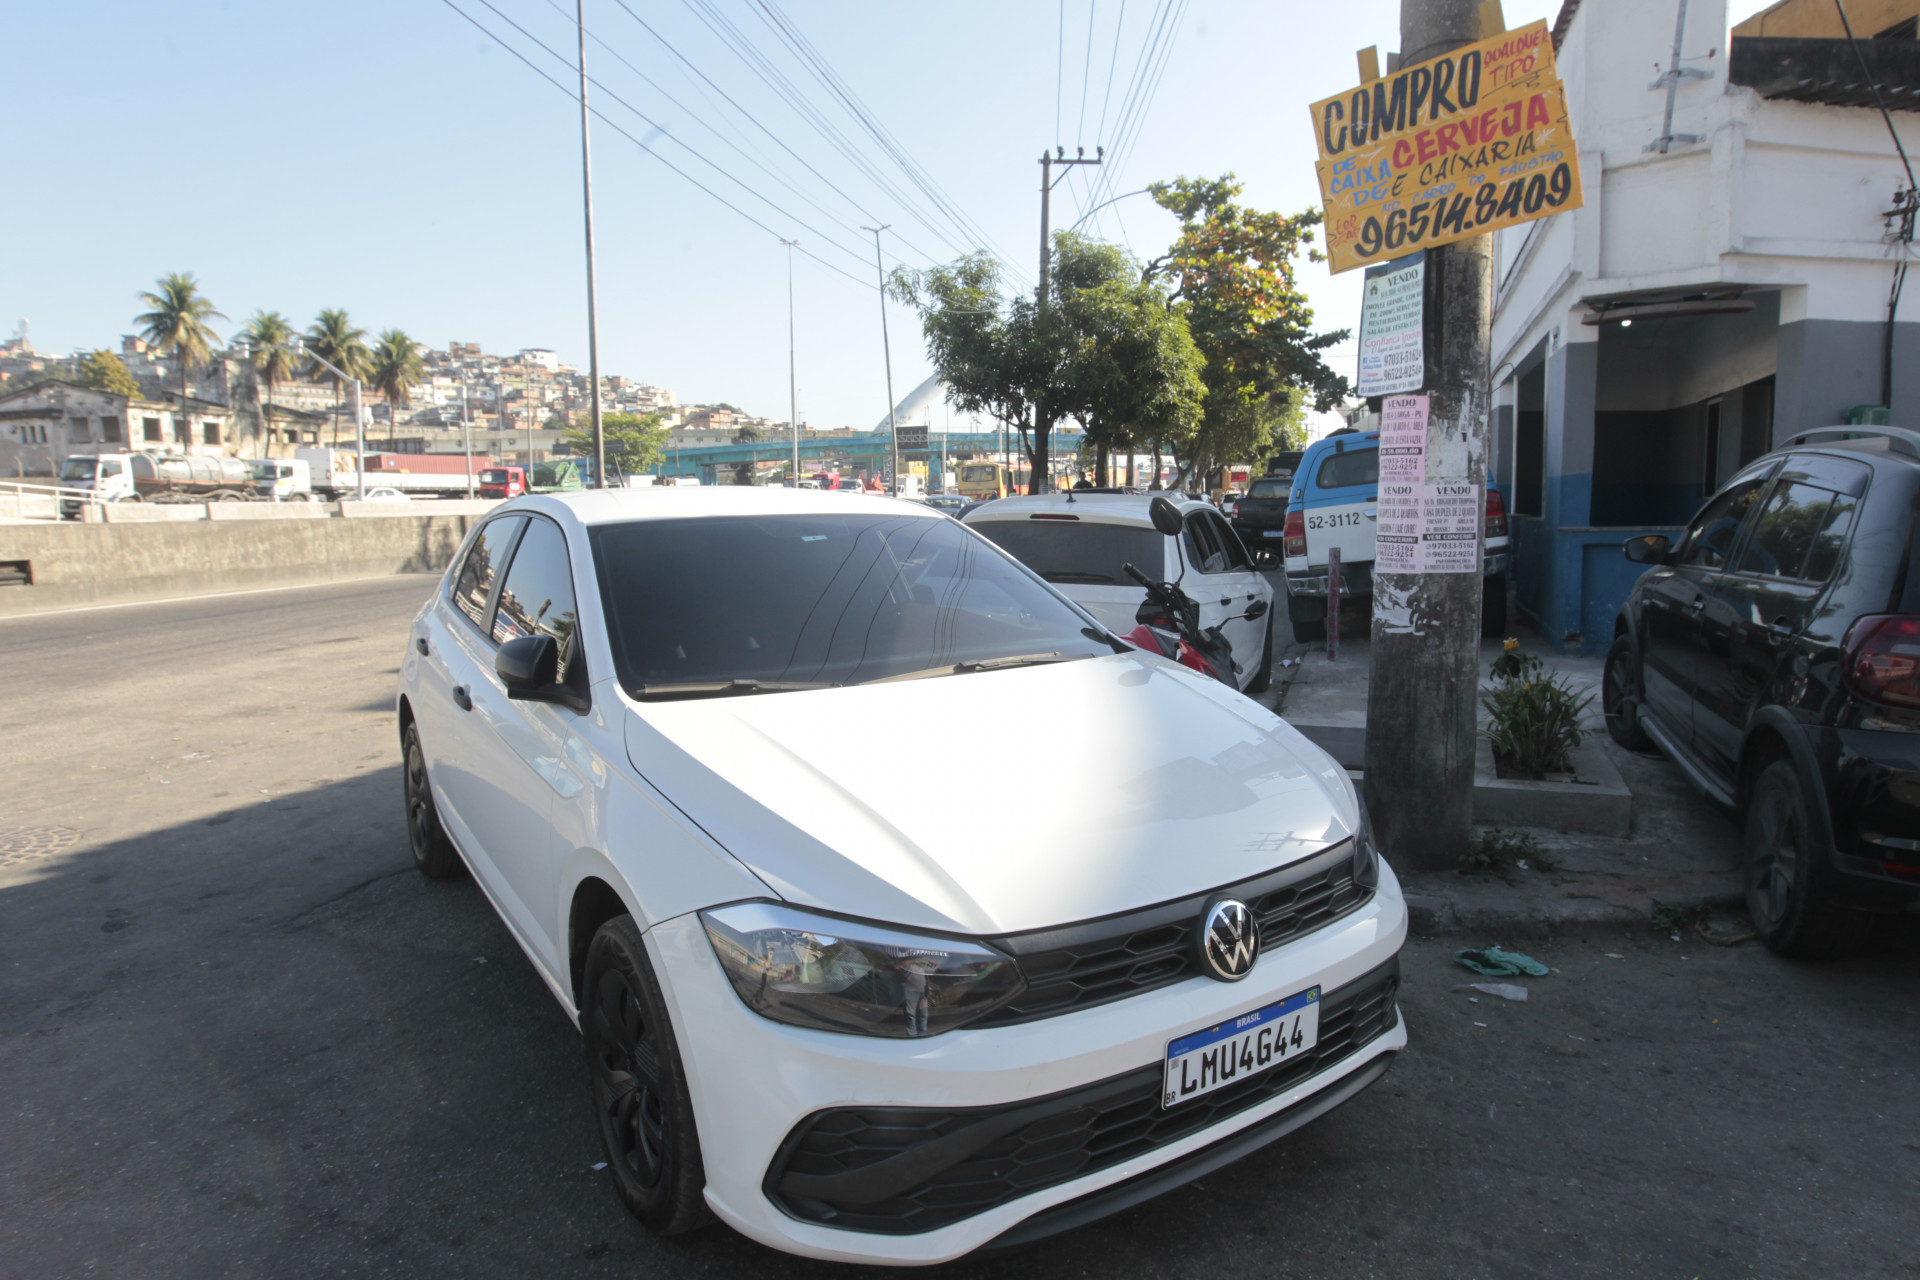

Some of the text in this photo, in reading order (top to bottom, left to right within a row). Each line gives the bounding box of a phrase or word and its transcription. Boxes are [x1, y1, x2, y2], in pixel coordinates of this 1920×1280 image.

[1484, 27, 1549, 68] QUALQUER
[1490, 55, 1535, 87] TIPO
[1324, 50, 1482, 155] COMPRO
[1392, 93, 1550, 169] CERVEJA
[1332, 156, 1357, 176] DE
[1391, 131, 1536, 197] E CAIXARIA
[1330, 158, 1392, 195] CAIXA
[1352, 181, 1389, 207] DE
[1354, 162, 1571, 258] 96514.8409
[1388, 269, 1418, 287] VENDO
[1384, 348, 1419, 367] 97033-5162
[1388, 399, 1416, 409] VENDO
[1384, 486, 1412, 495] VENDO
[1436, 486, 1471, 495] VENDO
[1309, 512, 1360, 529] 52-3112
[1236, 1012, 1261, 1029] BRASIL
[1181, 1014, 1303, 1096] LMU4G44
[1166, 1091, 1176, 1104] BR
